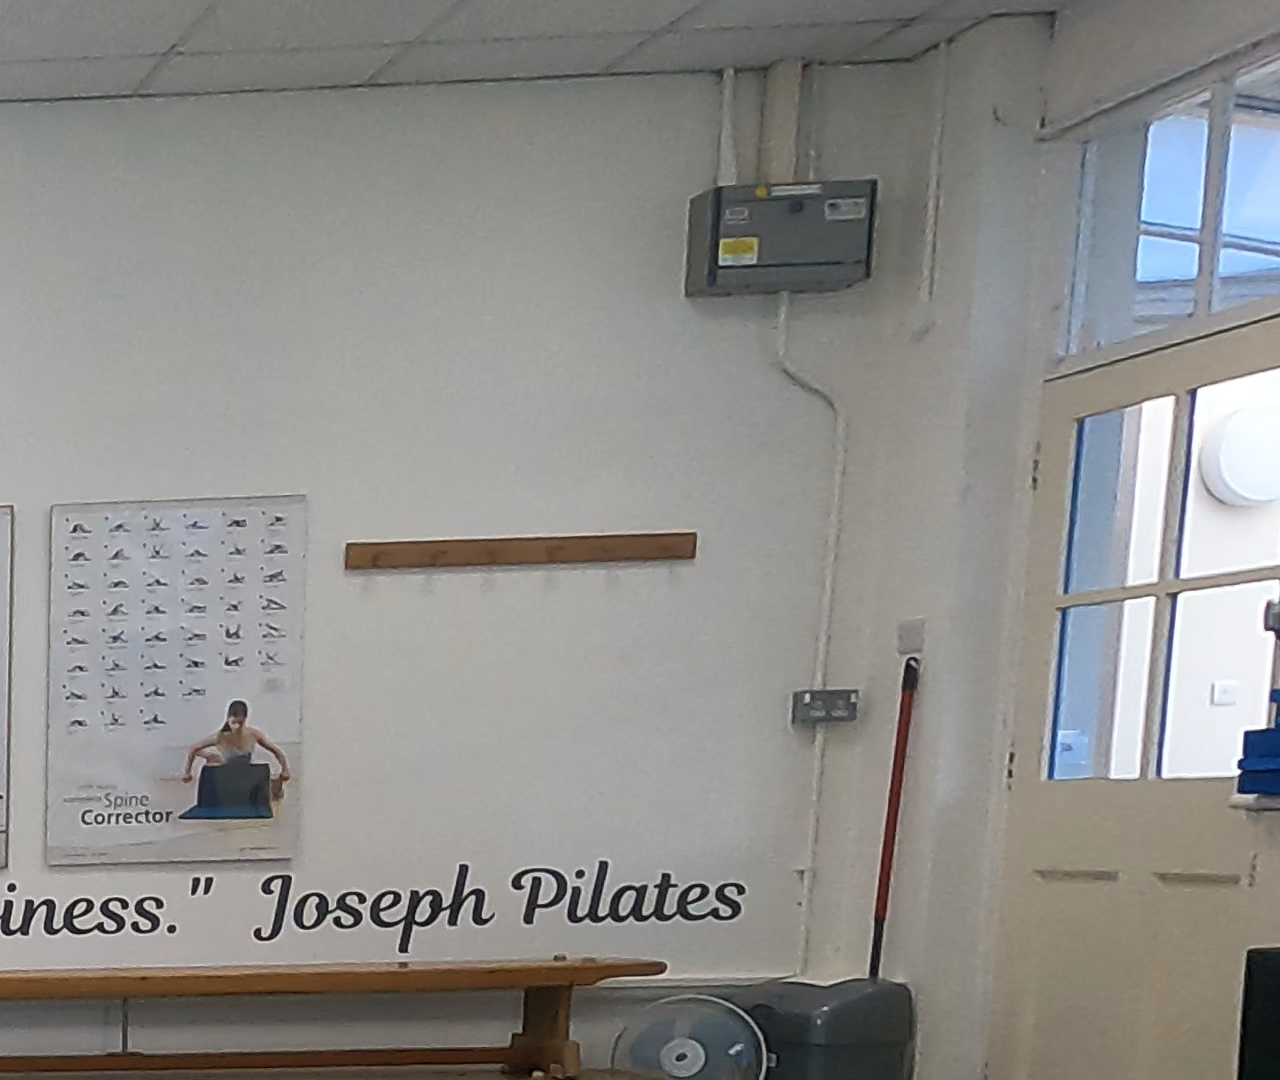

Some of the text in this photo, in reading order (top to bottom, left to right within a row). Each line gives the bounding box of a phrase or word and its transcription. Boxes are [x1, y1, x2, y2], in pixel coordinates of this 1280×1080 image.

[104, 792, 150, 811] Spine
[80, 809, 174, 826] Corrector
[253, 863, 496, 954] Joseph
[511, 860, 746, 925] Pilates
